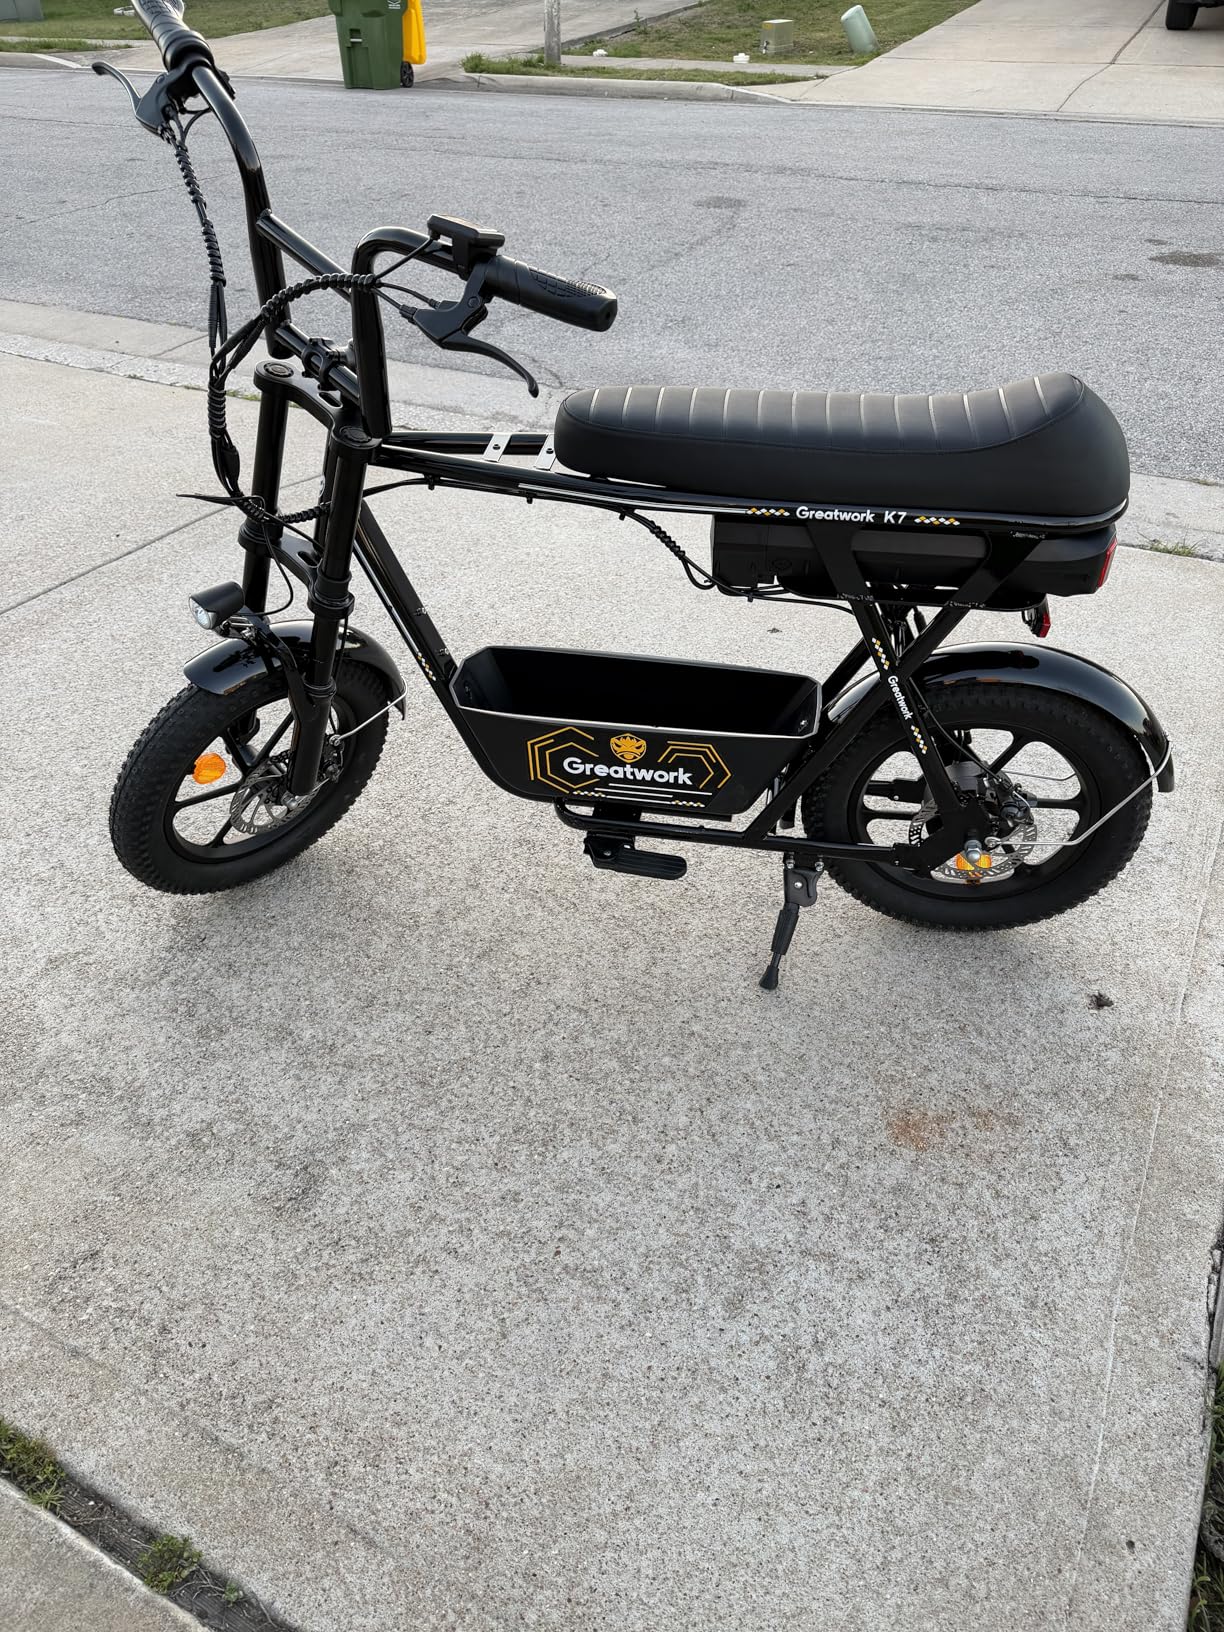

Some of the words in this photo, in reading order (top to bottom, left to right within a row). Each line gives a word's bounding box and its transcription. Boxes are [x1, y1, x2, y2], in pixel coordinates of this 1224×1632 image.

[796, 506, 875, 523] Greatwork
[884, 510, 907, 524] K7
[887, 675, 914, 720] Greatwork
[562, 756, 693, 785] Greatwork
